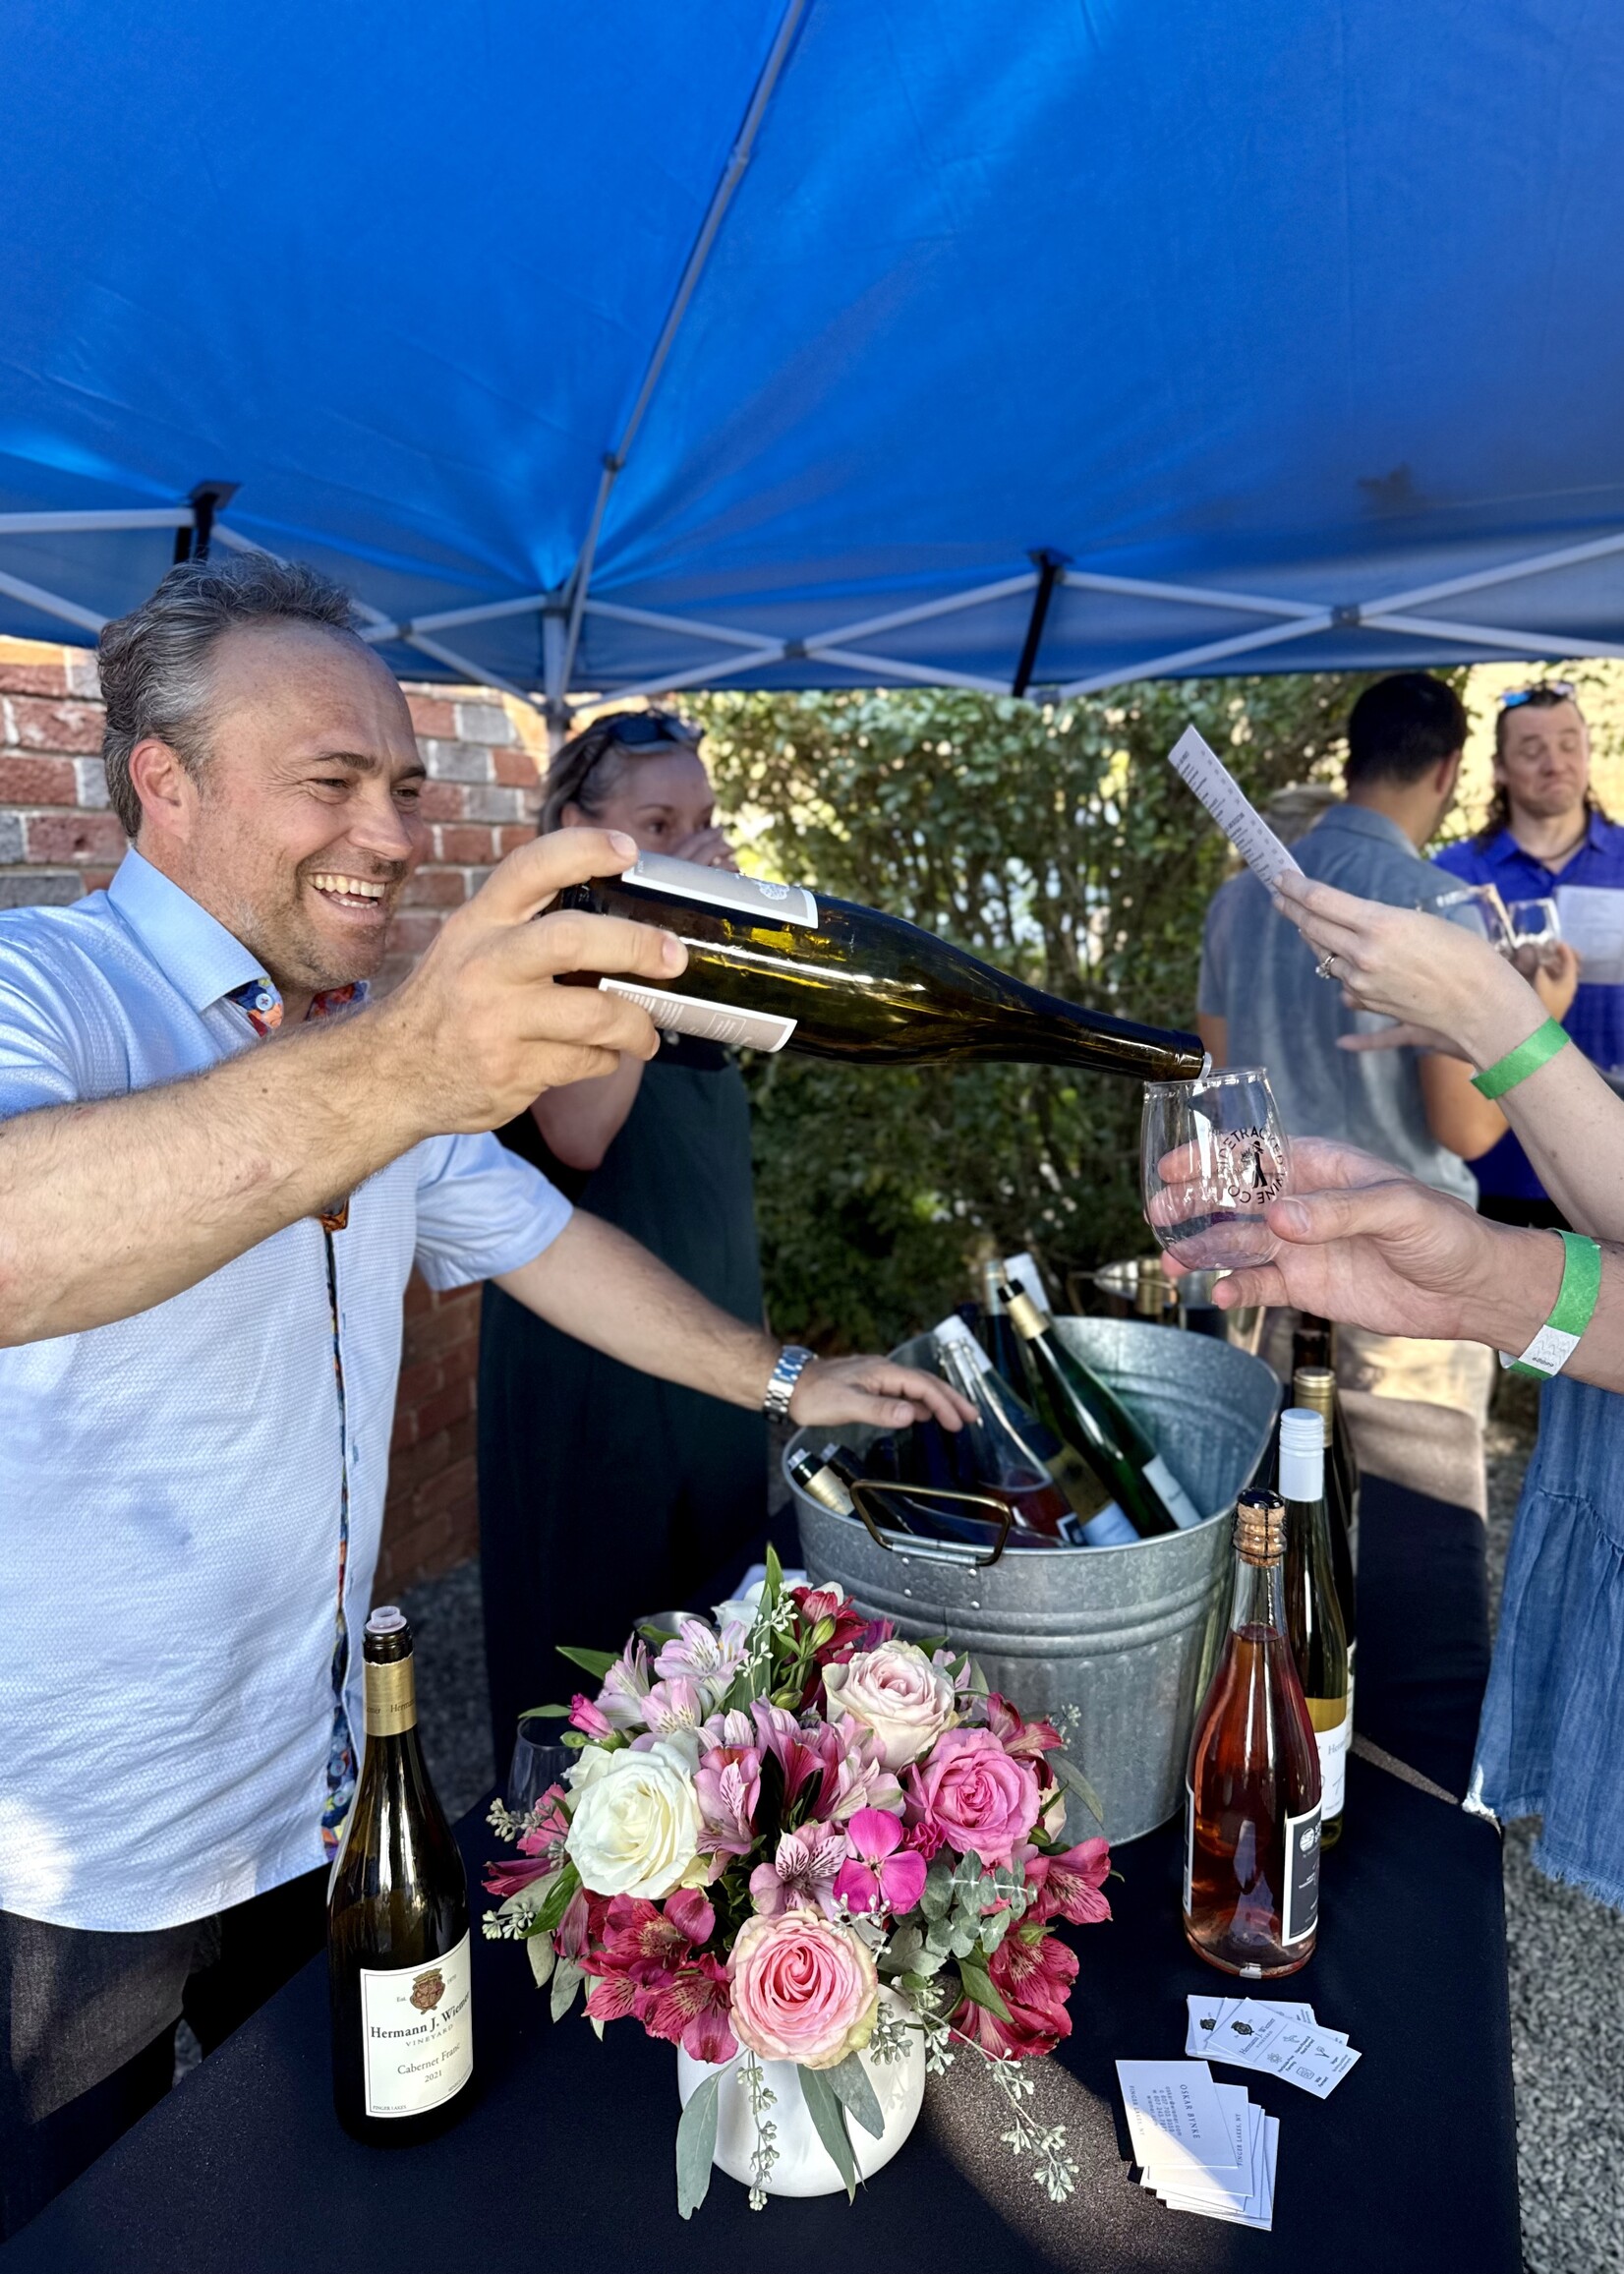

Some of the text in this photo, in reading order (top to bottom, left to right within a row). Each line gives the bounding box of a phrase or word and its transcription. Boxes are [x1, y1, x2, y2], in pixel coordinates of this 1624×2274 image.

[1228, 1185, 1251, 1203] CO
[371, 1991, 470, 2039] Hermann J. Wiemer
[406, 2023, 454, 2047] VINEYARD
[397, 2042, 460, 2074] Cabernet Franc
[424, 2070, 442, 2083] 2021
[1129, 2085, 1138, 2106] FINGER
[1180, 2083, 1201, 2139] OSKAR BYNKE
